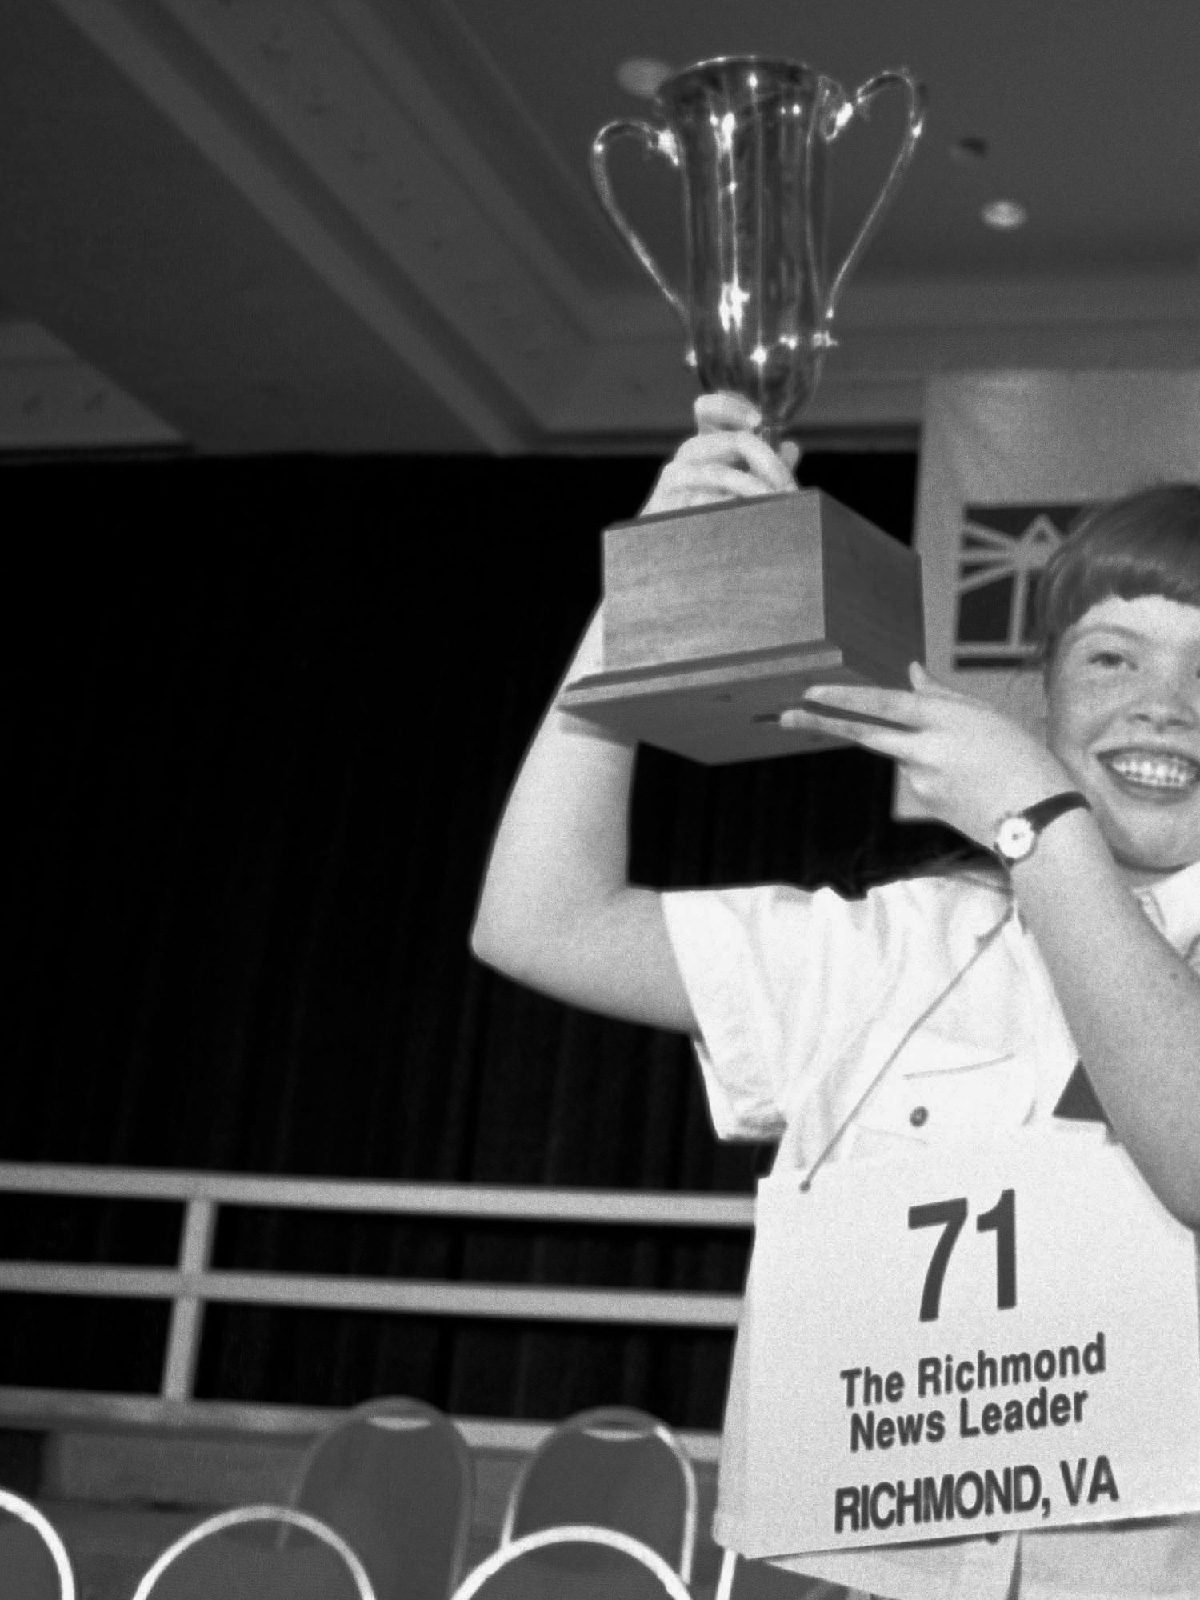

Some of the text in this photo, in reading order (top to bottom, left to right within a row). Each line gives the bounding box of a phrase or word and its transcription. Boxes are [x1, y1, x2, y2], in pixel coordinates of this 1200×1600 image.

[907, 1188, 1018, 1323] 71
[840, 1331, 1106, 1408] The Richmond
[850, 1386, 1090, 1453] News Leader
[833, 1455, 1121, 1534] RICHMOND, VA
